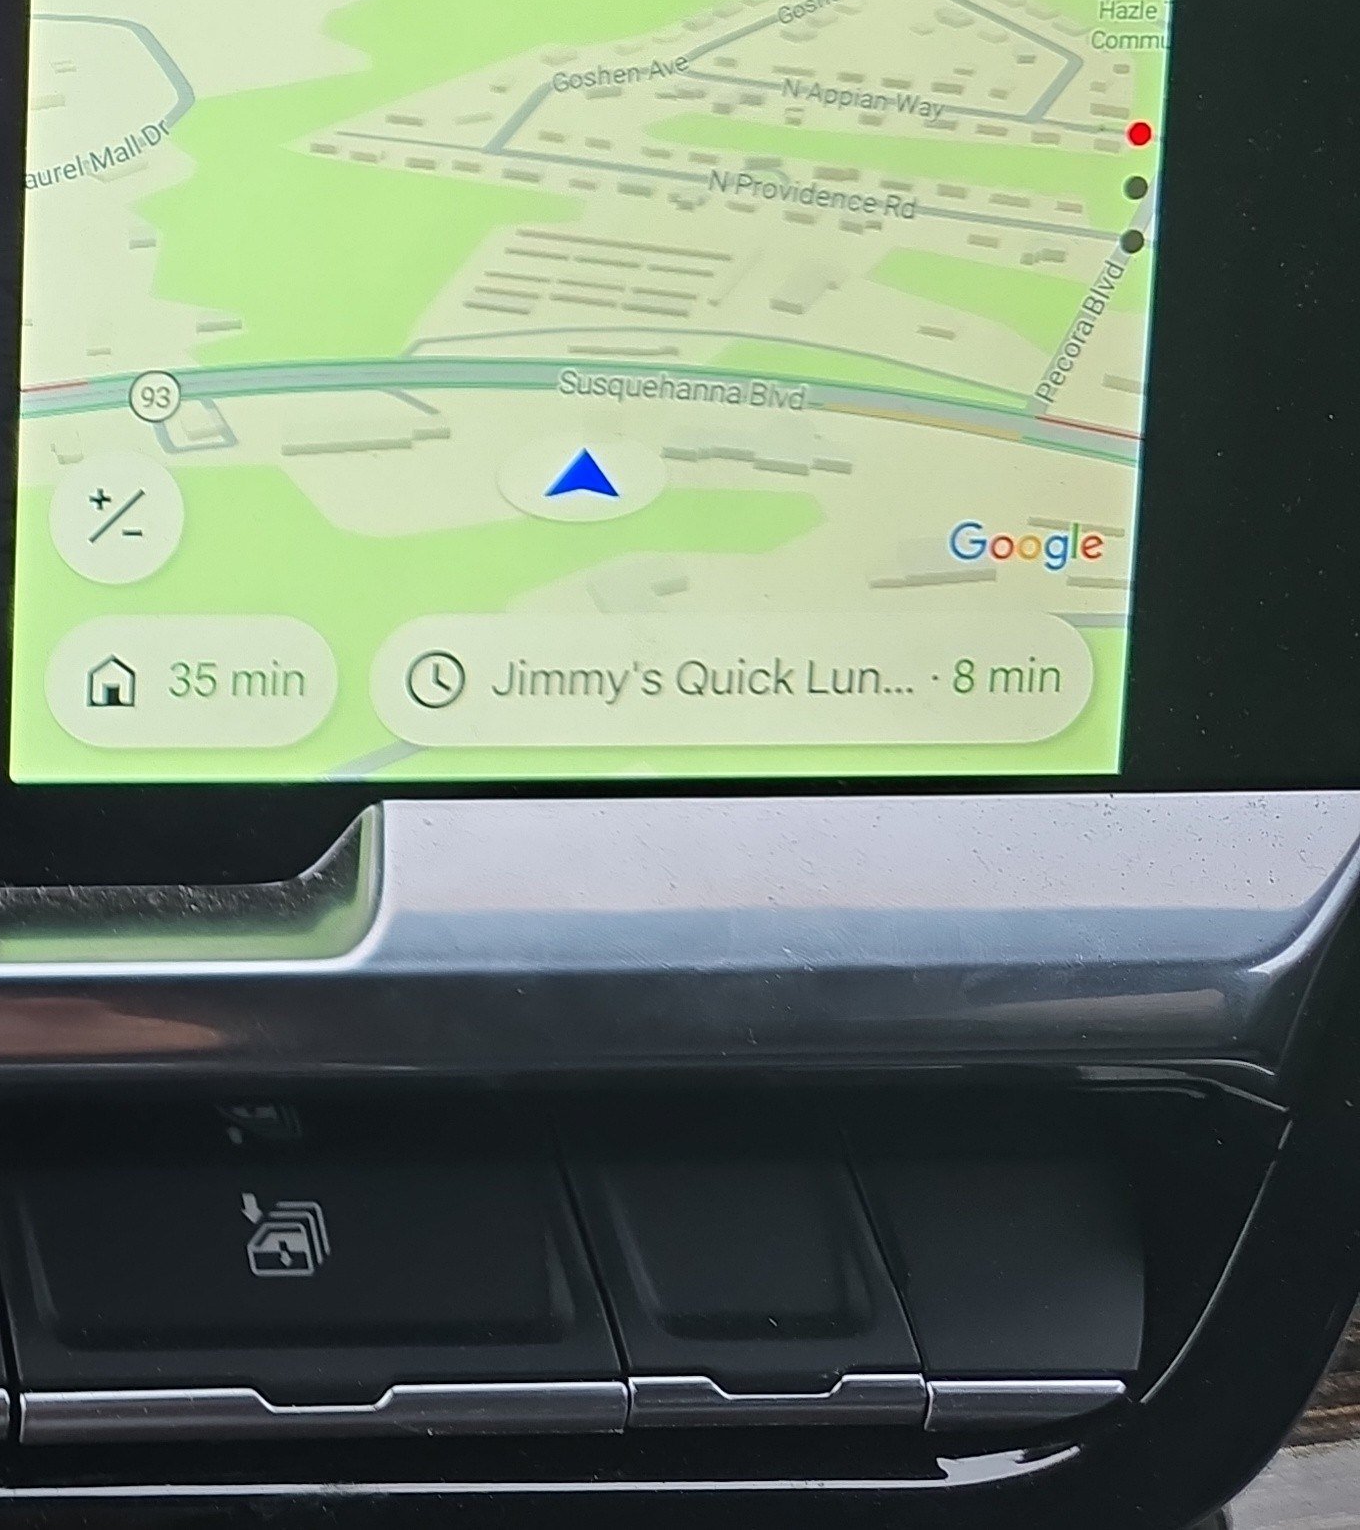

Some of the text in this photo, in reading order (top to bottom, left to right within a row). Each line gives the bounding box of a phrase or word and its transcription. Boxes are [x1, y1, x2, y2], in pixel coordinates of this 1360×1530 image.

[1099, 0, 1158, 20] Hazle
[553, 55, 689, 93] Goshen Ave
[782, 79, 945, 120] N Appian Way
[89, 134, 142, 173] Mall
[141, 119, 170, 147] Dr
[708, 170, 918, 220] N Providence Rd
[1034, 259, 1126, 404] Pecora Blvd
[140, 386, 171, 409] 93
[559, 369, 806, 411] Susquehanna Blvd
[950, 522, 1104, 571] Google
[168, 659, 305, 698] 35 min
[491, 659, 663, 706] Jimmy's
[676, 657, 794, 696] Quick
[807, 660, 914, 695] Lun...
[953, 658, 975, 694] 8
[989, 656, 1061, 693] min
